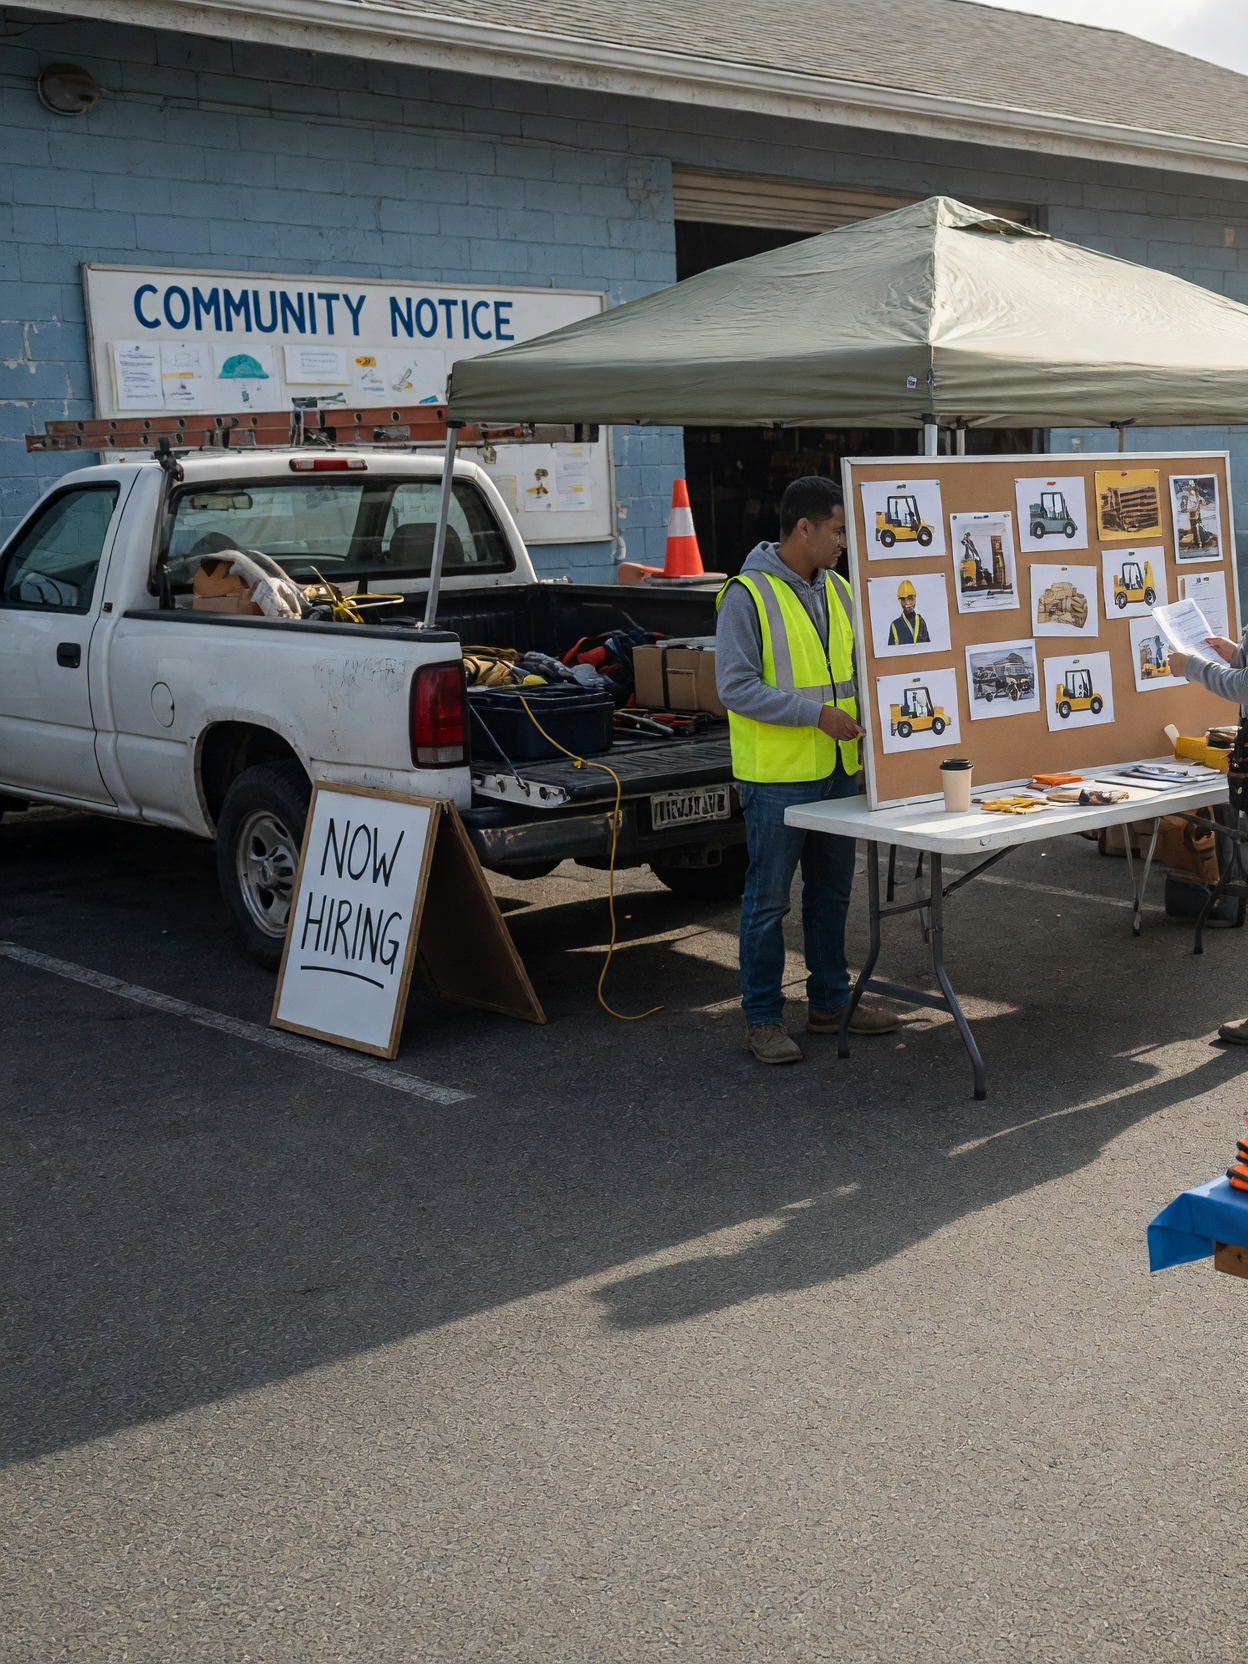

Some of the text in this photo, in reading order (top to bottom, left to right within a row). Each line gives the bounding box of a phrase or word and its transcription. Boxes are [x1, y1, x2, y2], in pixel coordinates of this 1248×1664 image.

[133, 283, 515, 341] COMMUNITY NOTICE
[319, 817, 405, 888] NOW
[300, 891, 403, 975] HIRING
